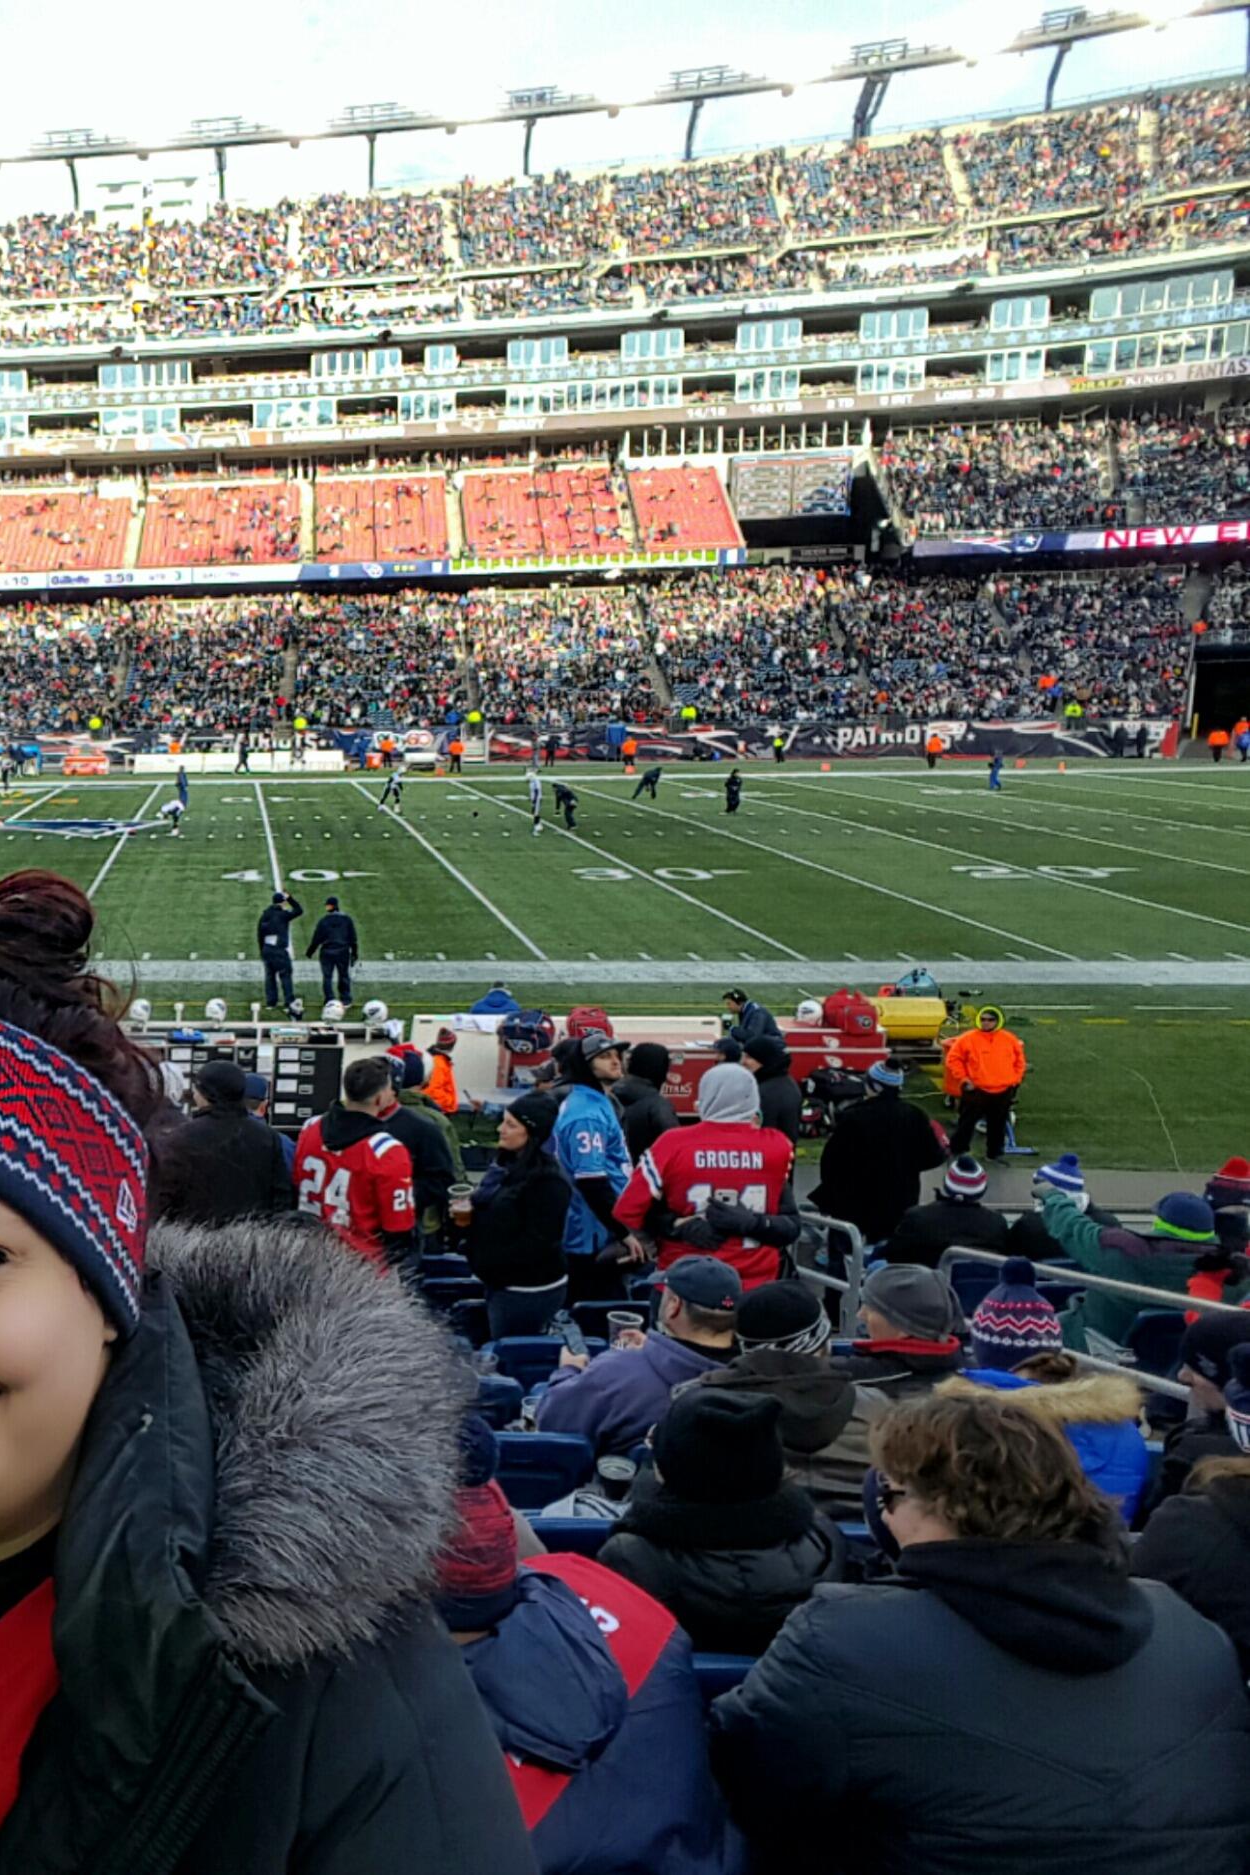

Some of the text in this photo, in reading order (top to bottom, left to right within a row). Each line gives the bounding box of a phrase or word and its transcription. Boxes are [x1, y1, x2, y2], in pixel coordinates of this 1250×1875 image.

[1104, 521, 1250, 549] NEW E
[220, 869, 340, 882] 40
[571, 867, 714, 881] 30
[576, 1131, 604, 1154] 34
[694, 1149, 764, 1170] GROGAN
[298, 1155, 351, 1229] 24
